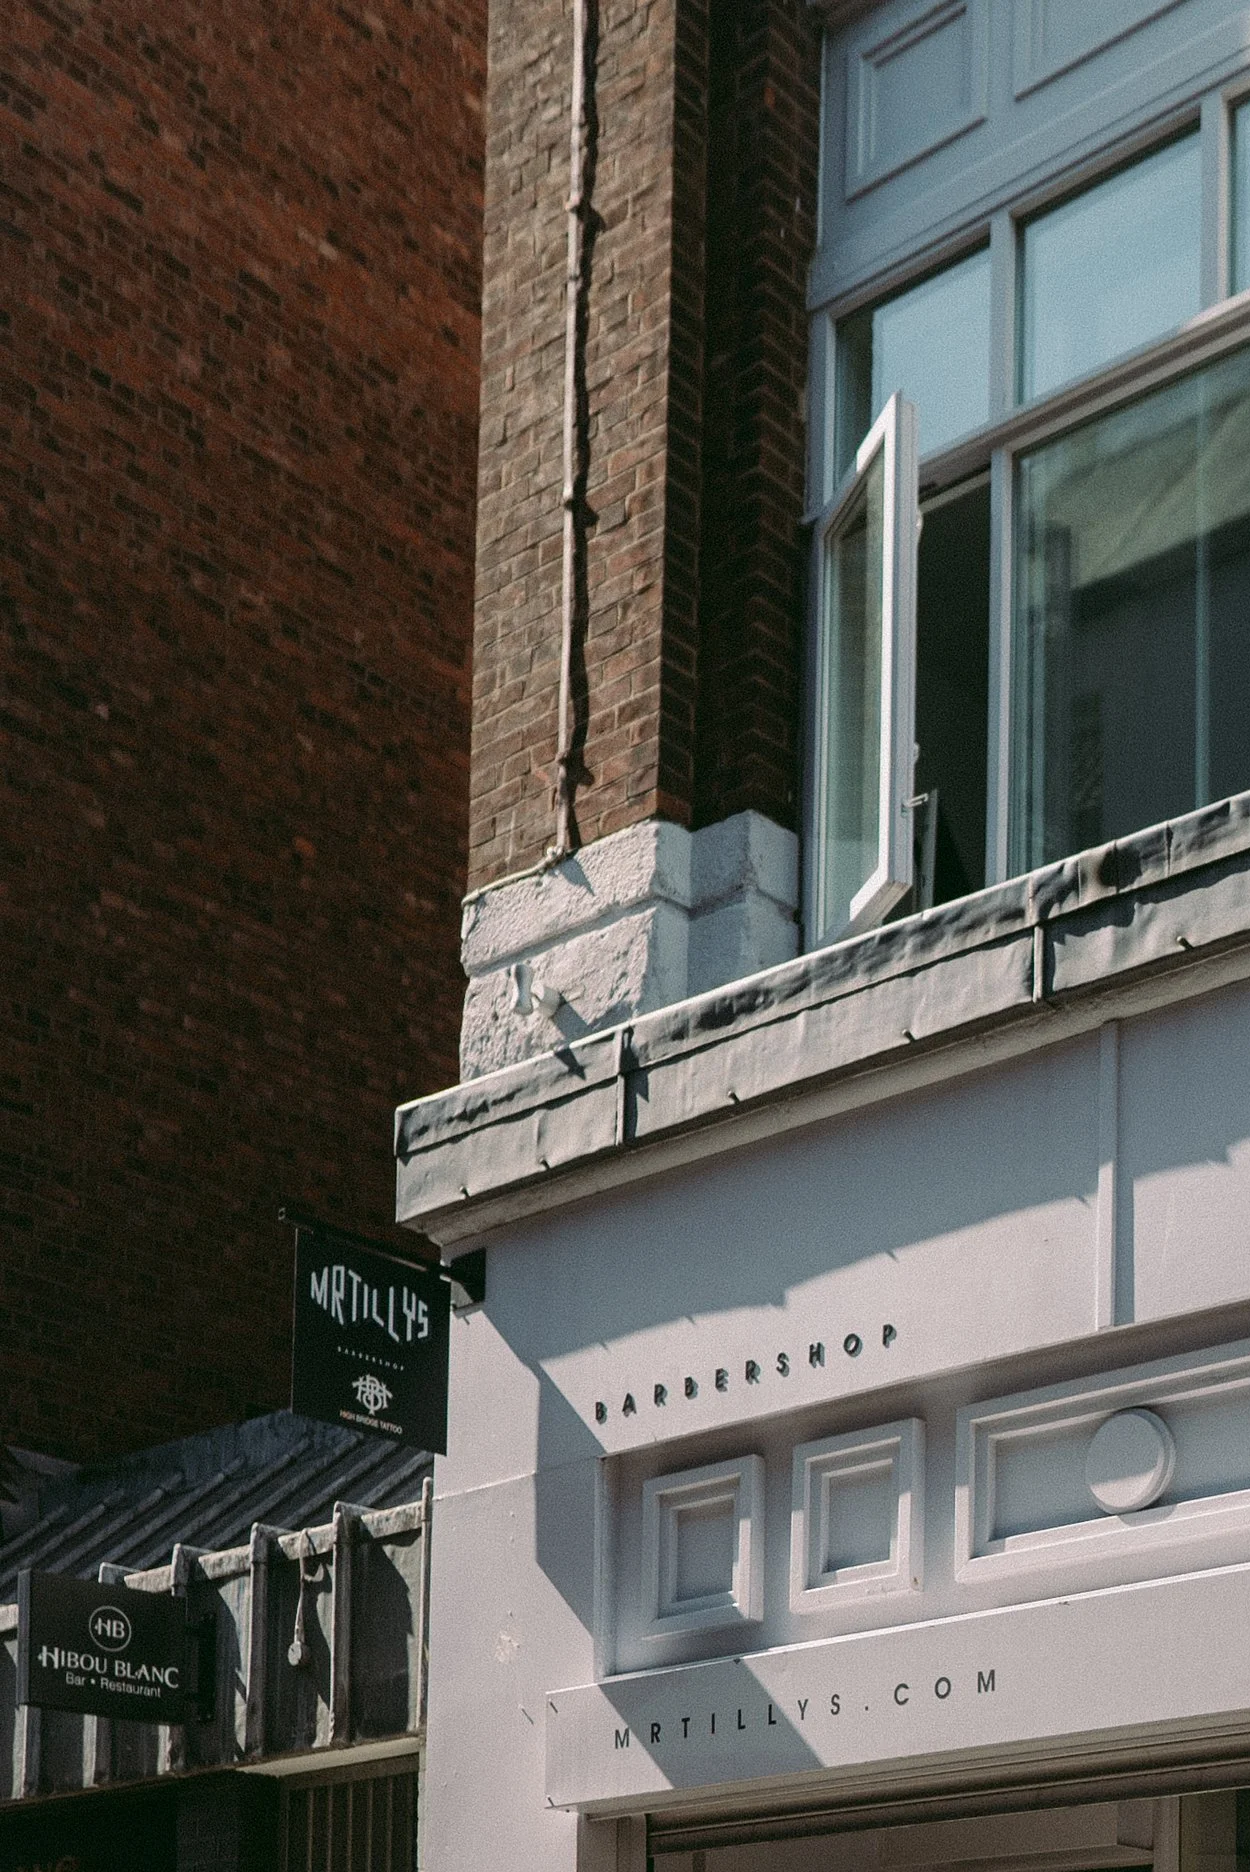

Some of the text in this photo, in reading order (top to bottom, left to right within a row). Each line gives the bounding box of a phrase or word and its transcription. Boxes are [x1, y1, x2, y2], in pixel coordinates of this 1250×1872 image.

[310, 1265, 429, 1342] MRTILLYS
[595, 1324, 898, 1422] BARBERSHOP
[380, 1420, 403, 1435] TATTOO
[38, 1645, 179, 1689] HIBOU BLANC
[66, 1672, 161, 1698] Bar Restaurant
[614, 1669, 997, 1749] MRTILLYS.COM
